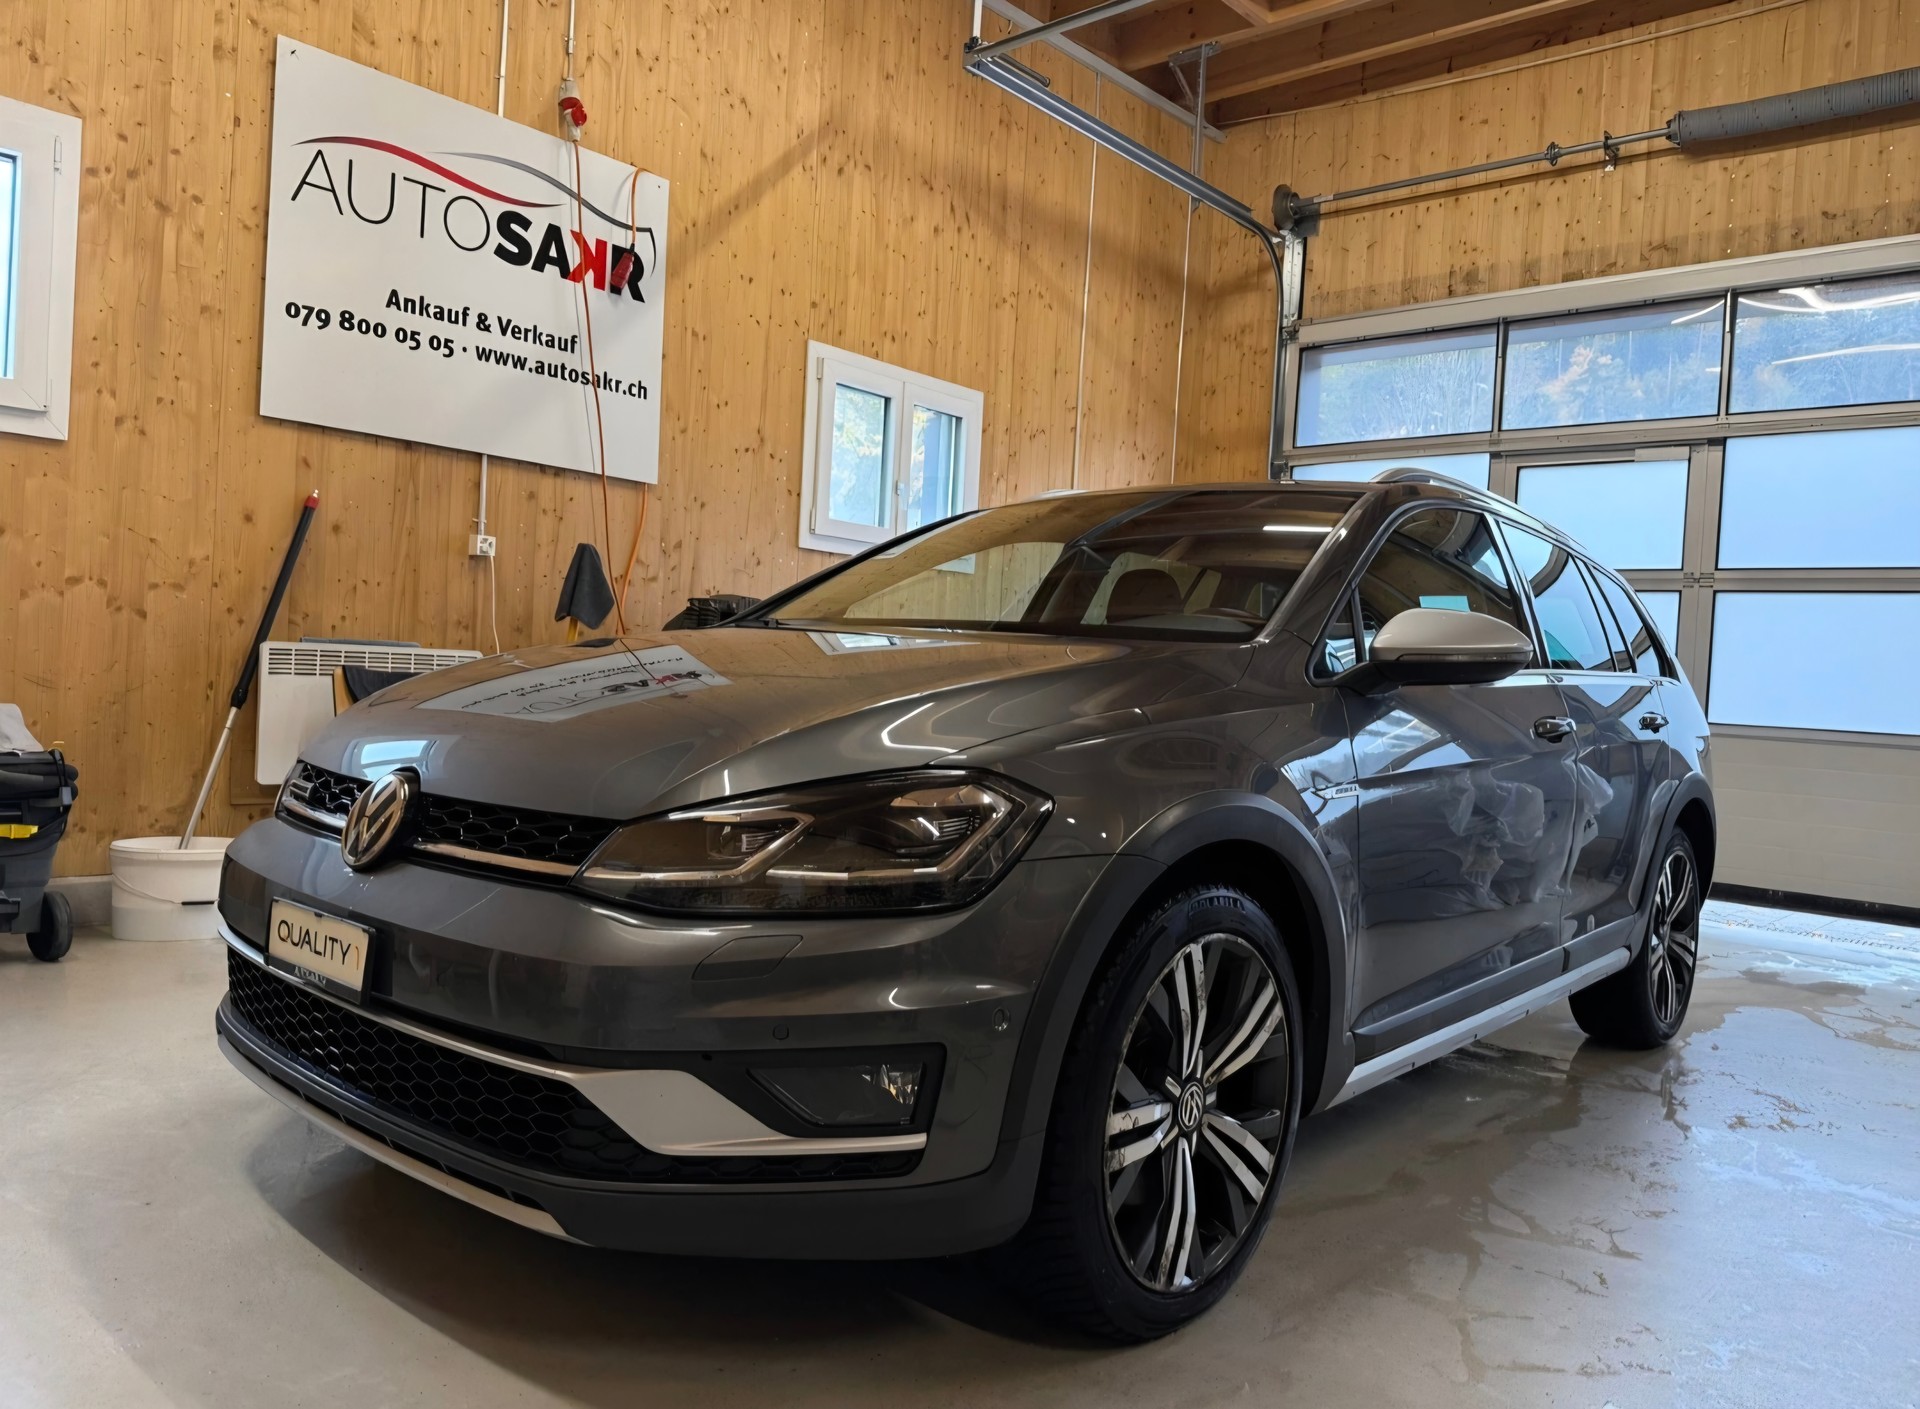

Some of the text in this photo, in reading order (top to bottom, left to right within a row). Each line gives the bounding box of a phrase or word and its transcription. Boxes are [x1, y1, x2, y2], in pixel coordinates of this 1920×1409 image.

[290, 149, 646, 304] AUTOSAKR
[285, 301, 331, 330] 079
[339, 310, 387, 338] 800
[394, 327, 421, 350] 05
[428, 334, 455, 358] 05
[385, 288, 578, 354] Ankauf & Verkauf
